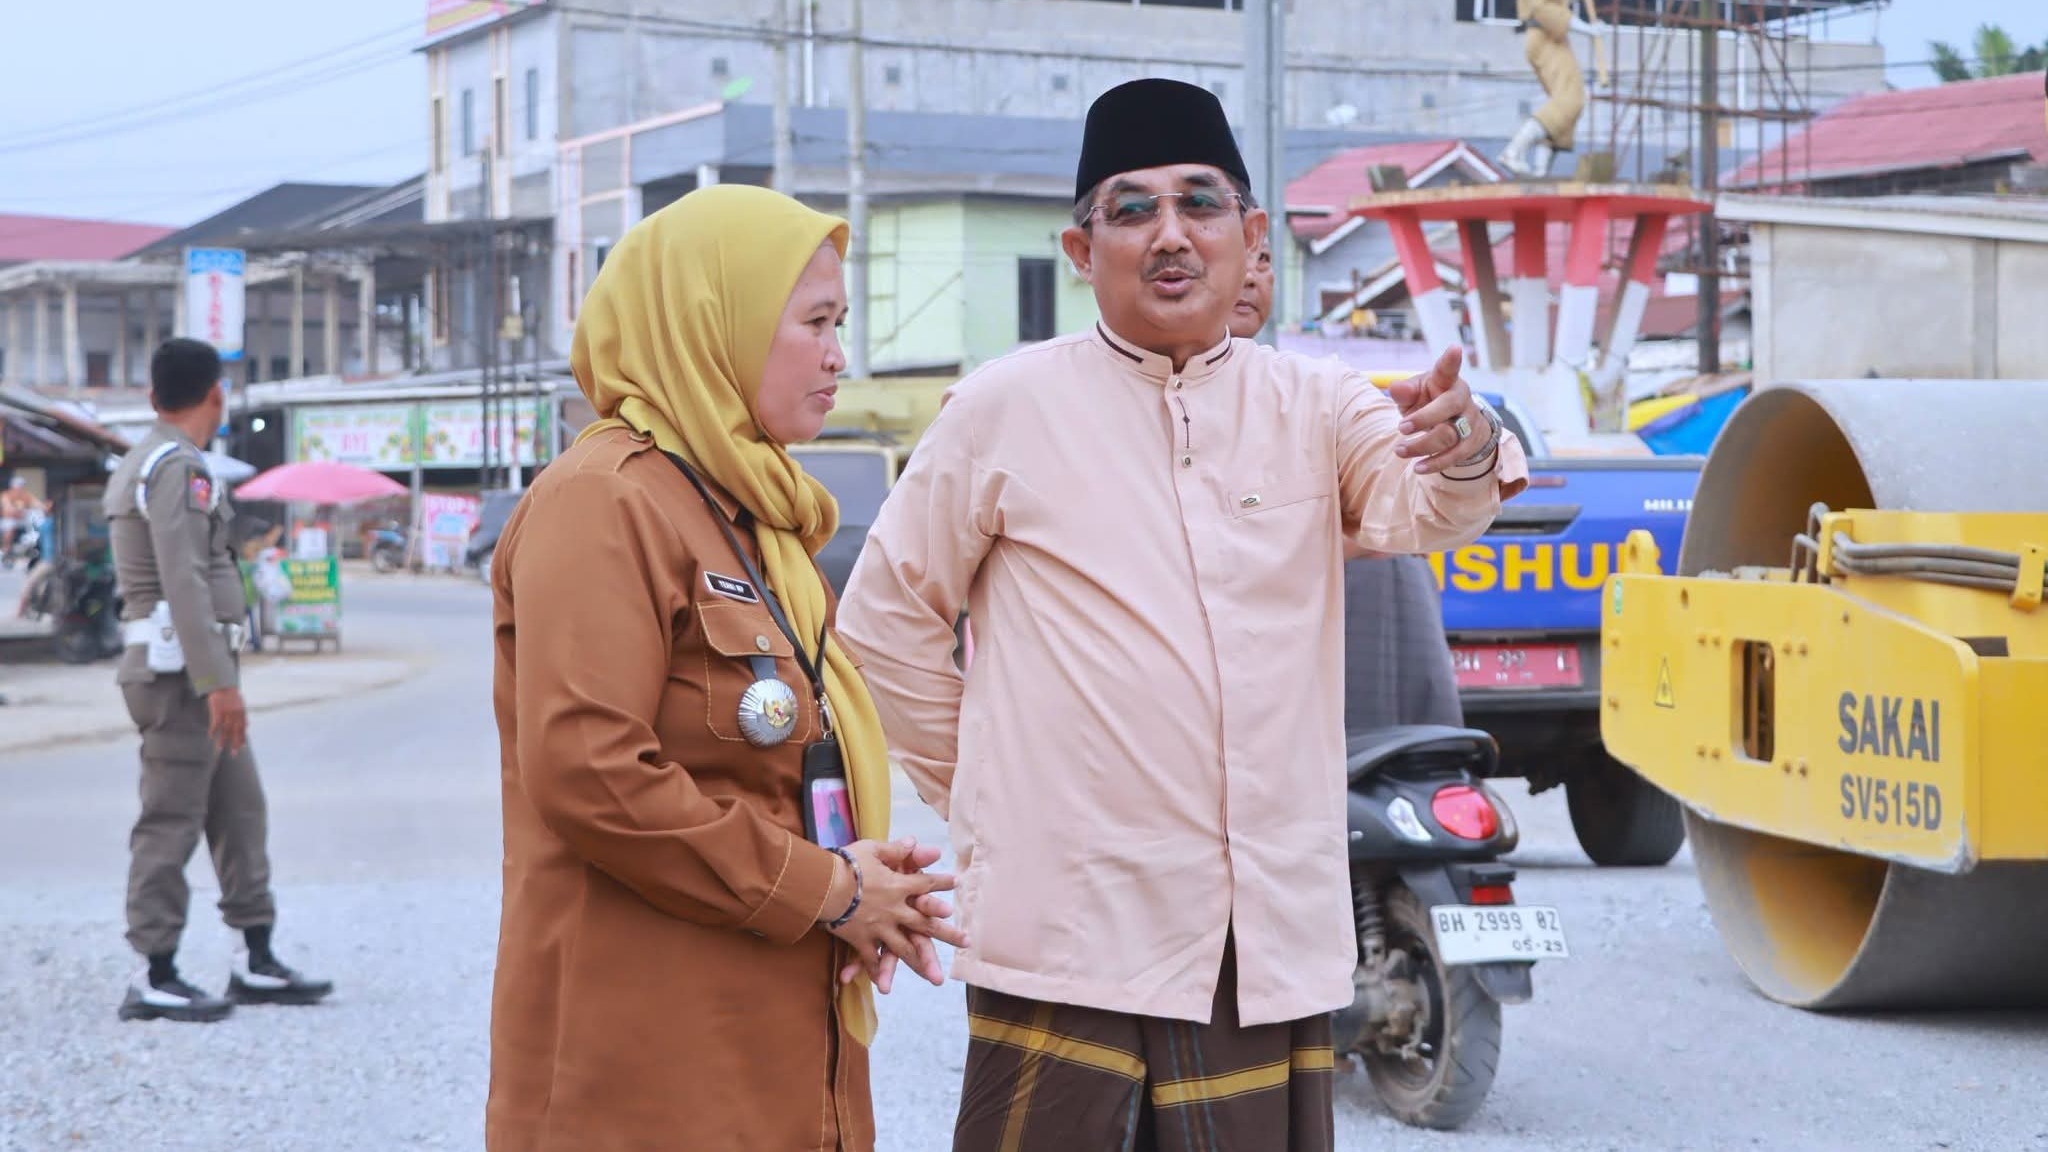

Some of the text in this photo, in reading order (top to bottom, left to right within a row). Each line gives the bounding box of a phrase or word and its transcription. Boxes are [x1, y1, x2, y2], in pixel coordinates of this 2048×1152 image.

[1838, 690, 1940, 763] SAKAI
[1840, 773, 1942, 831] SV515D
[1438, 912, 1466, 932] BH
[1474, 911, 1523, 932] 2999
